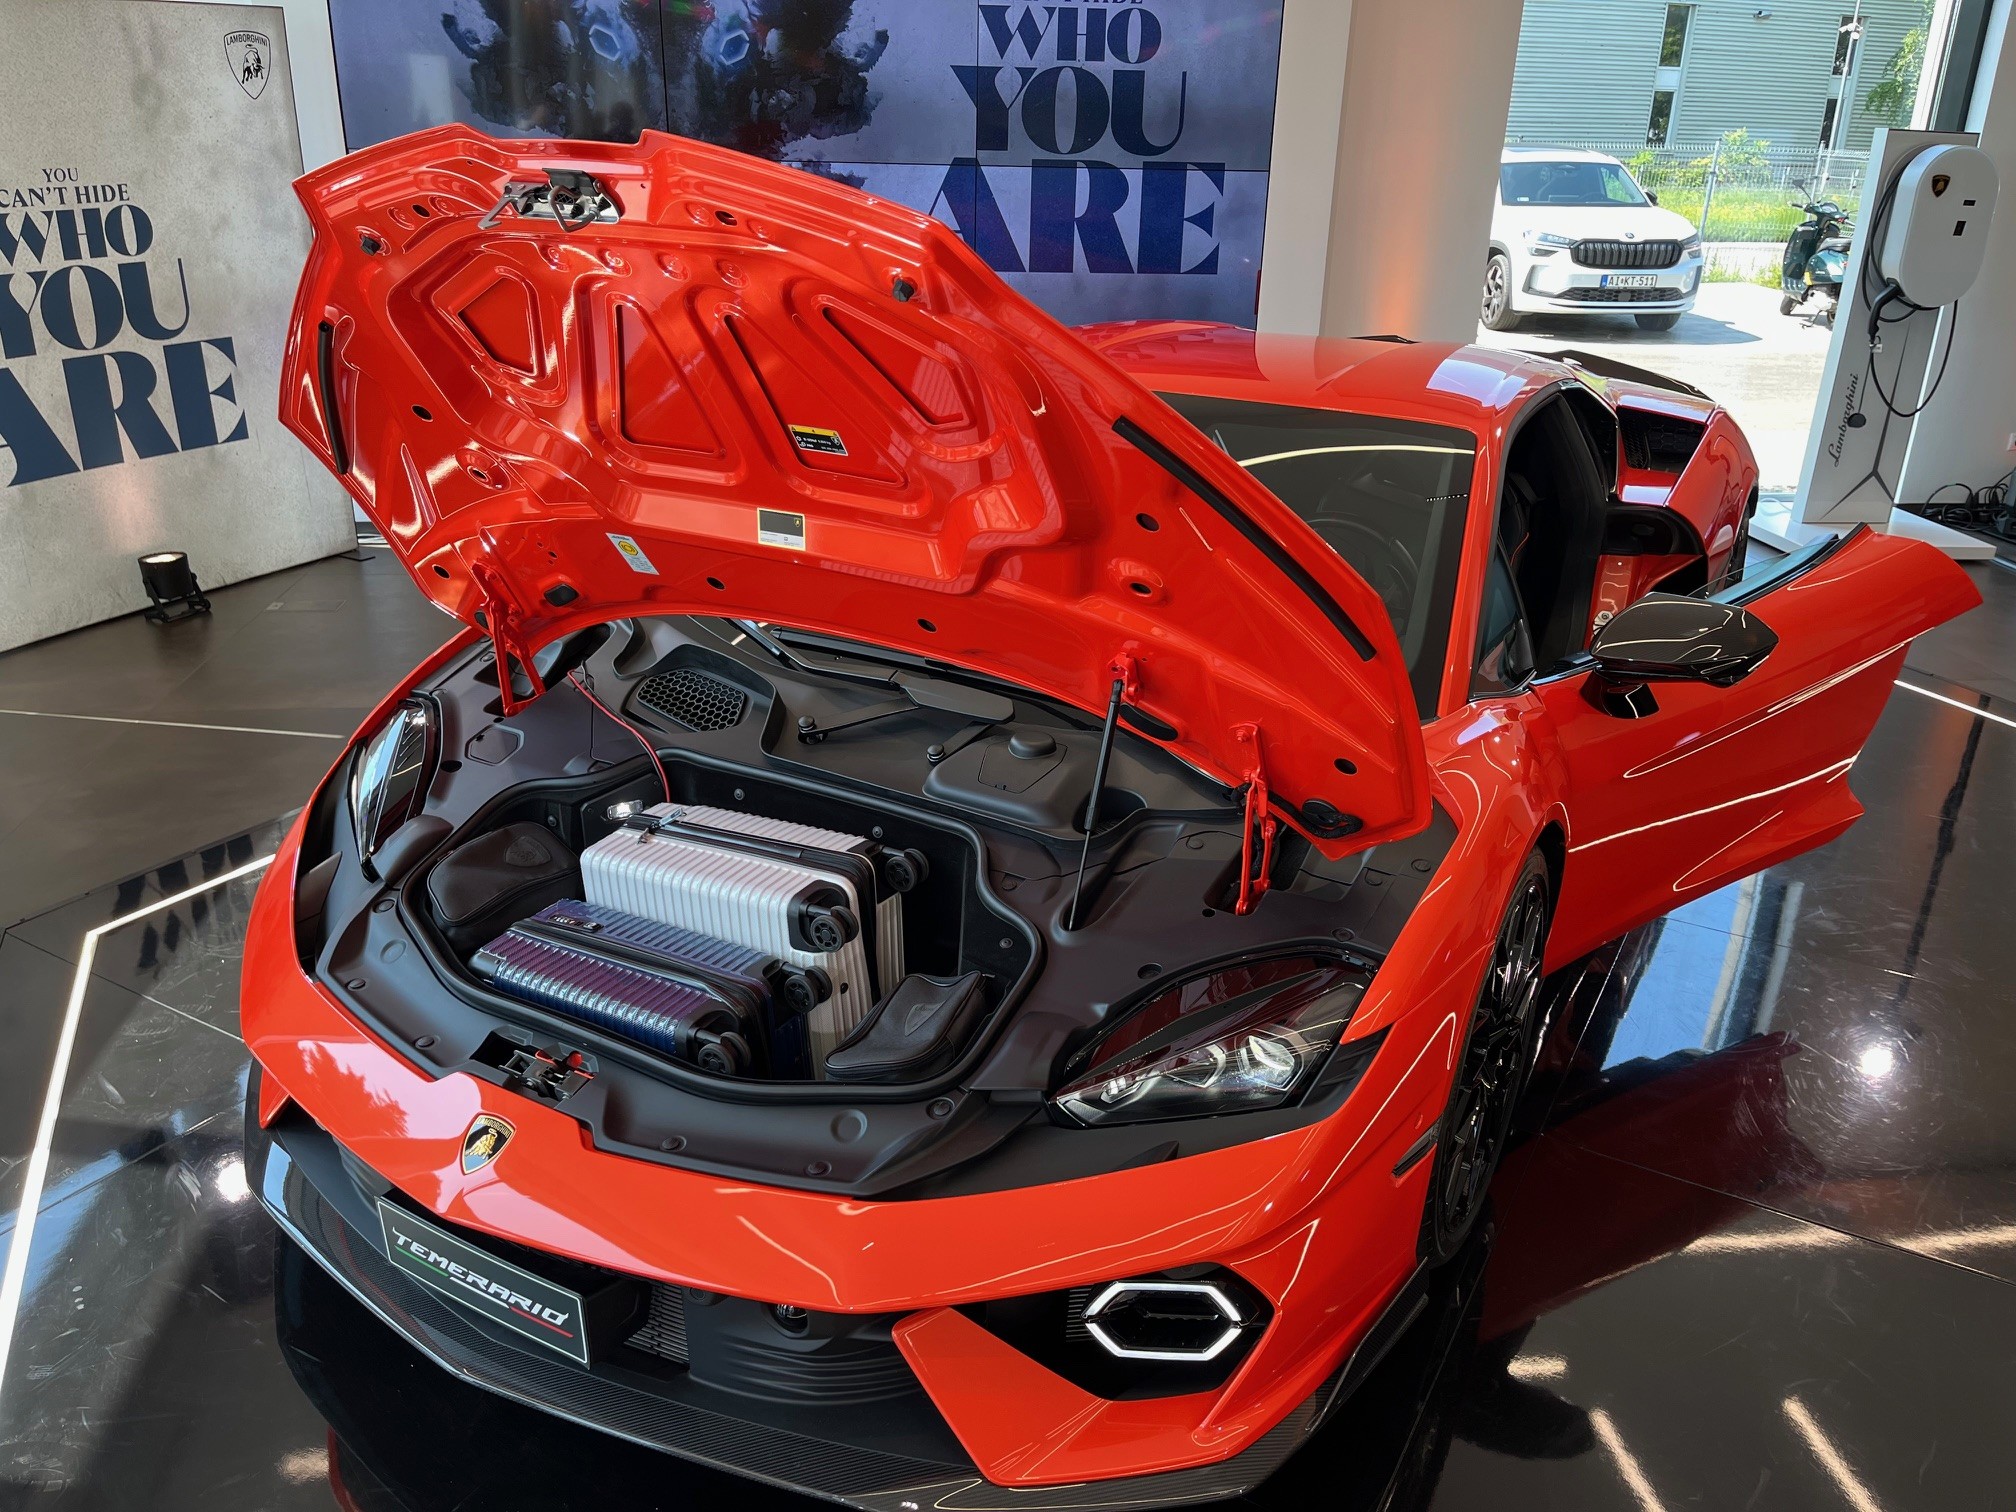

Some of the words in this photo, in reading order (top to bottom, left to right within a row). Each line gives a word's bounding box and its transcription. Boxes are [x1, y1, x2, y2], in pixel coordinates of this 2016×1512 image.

[226, 33, 268, 47] LAMBORGHINI
[979, 5, 1162, 64] WHO
[950, 65, 1187, 156] YOU
[0, 185, 68, 208] CAN'T
[74, 183, 130, 204] HIDE
[42, 167, 79, 182] YOU
[929, 157, 1226, 275] ARE
[0, 204, 153, 267] WHO
[0, 258, 189, 359] YOU
[0, 336, 249, 487] ARE
[1828, 373, 1859, 468] Lamborghini
[392, 1226, 569, 1326] TEMERARIO
